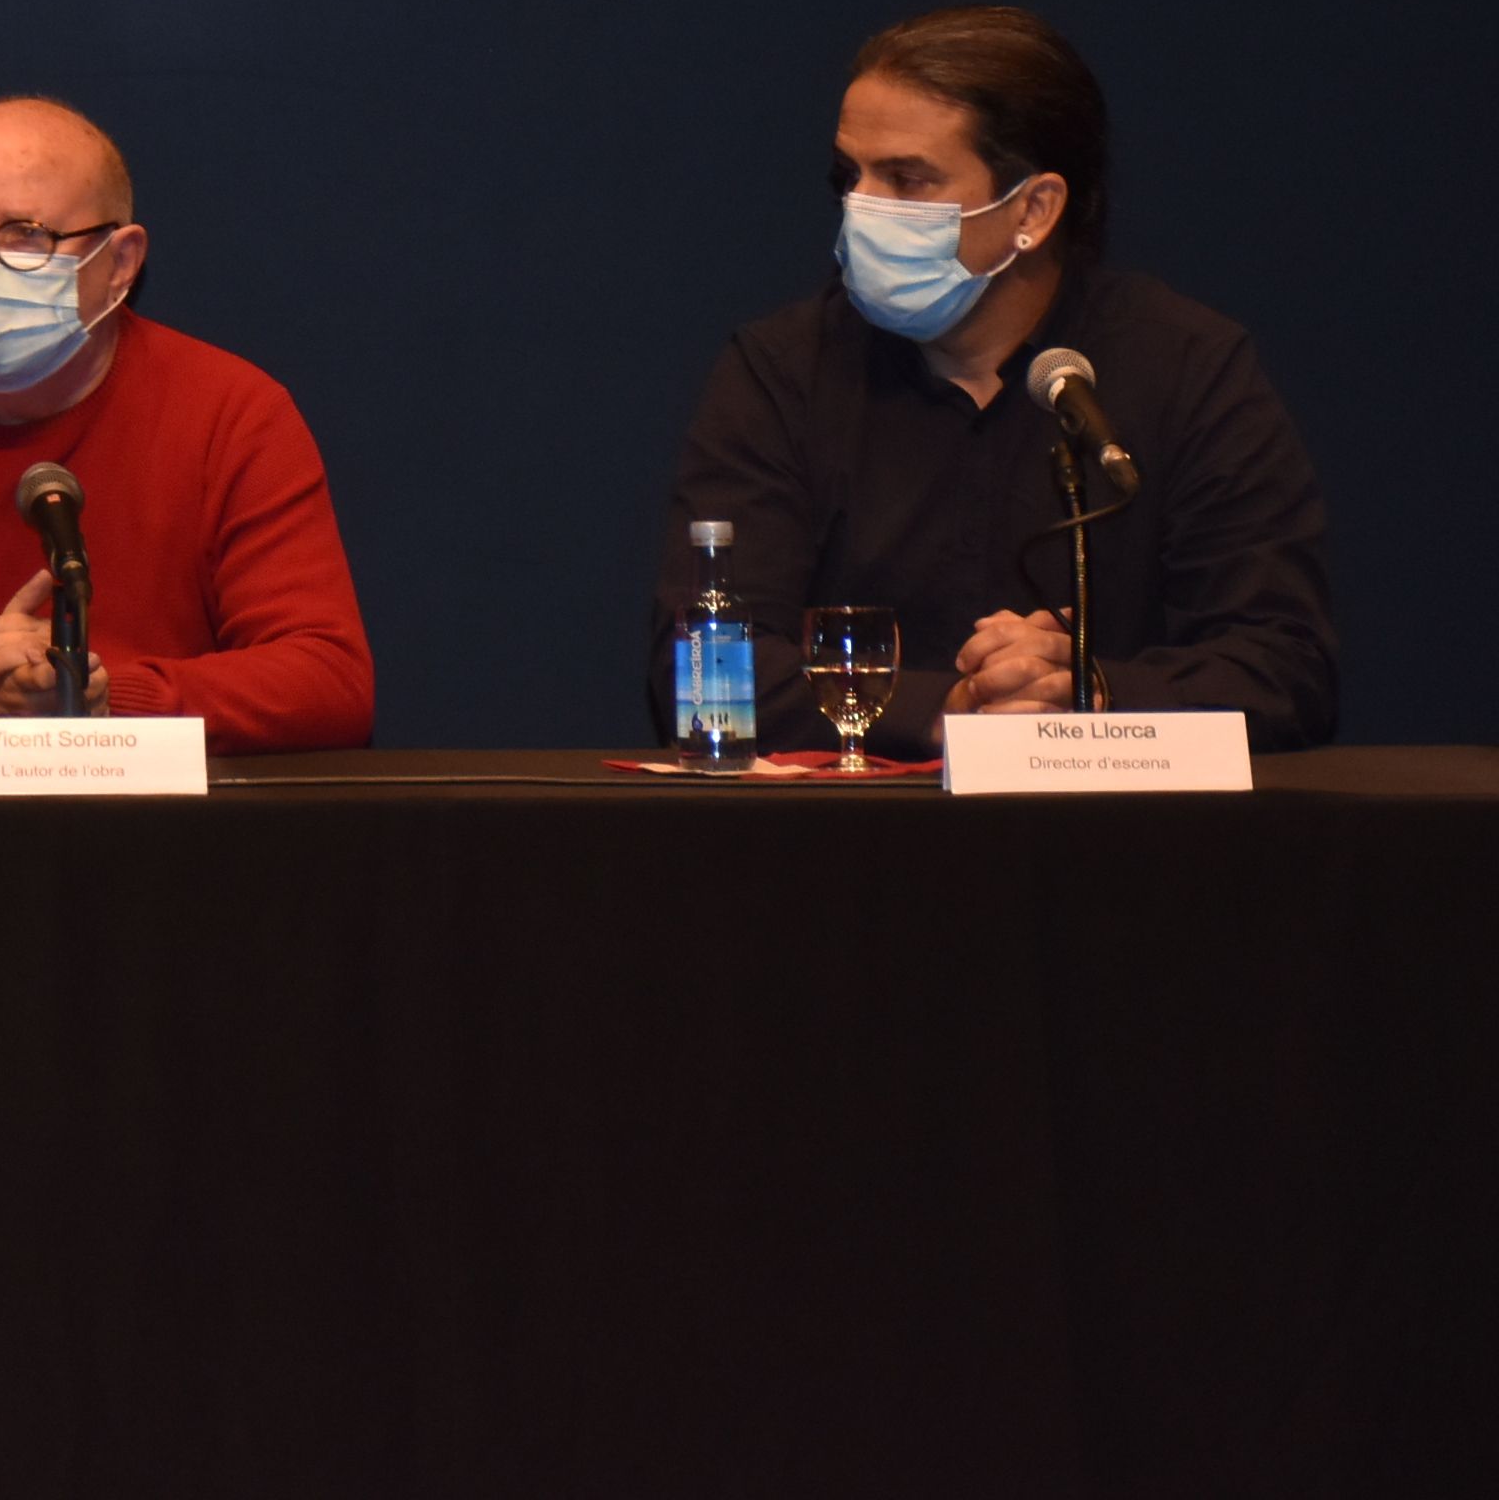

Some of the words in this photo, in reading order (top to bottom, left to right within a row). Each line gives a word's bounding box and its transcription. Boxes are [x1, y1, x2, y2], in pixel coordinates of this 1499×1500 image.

[1037, 721, 1084, 739] Kike
[1090, 721, 1157, 739] Llorca
[58, 730, 138, 748] Soriano
[1029, 755, 1092, 770] Director
[58, 764, 78, 778] de
